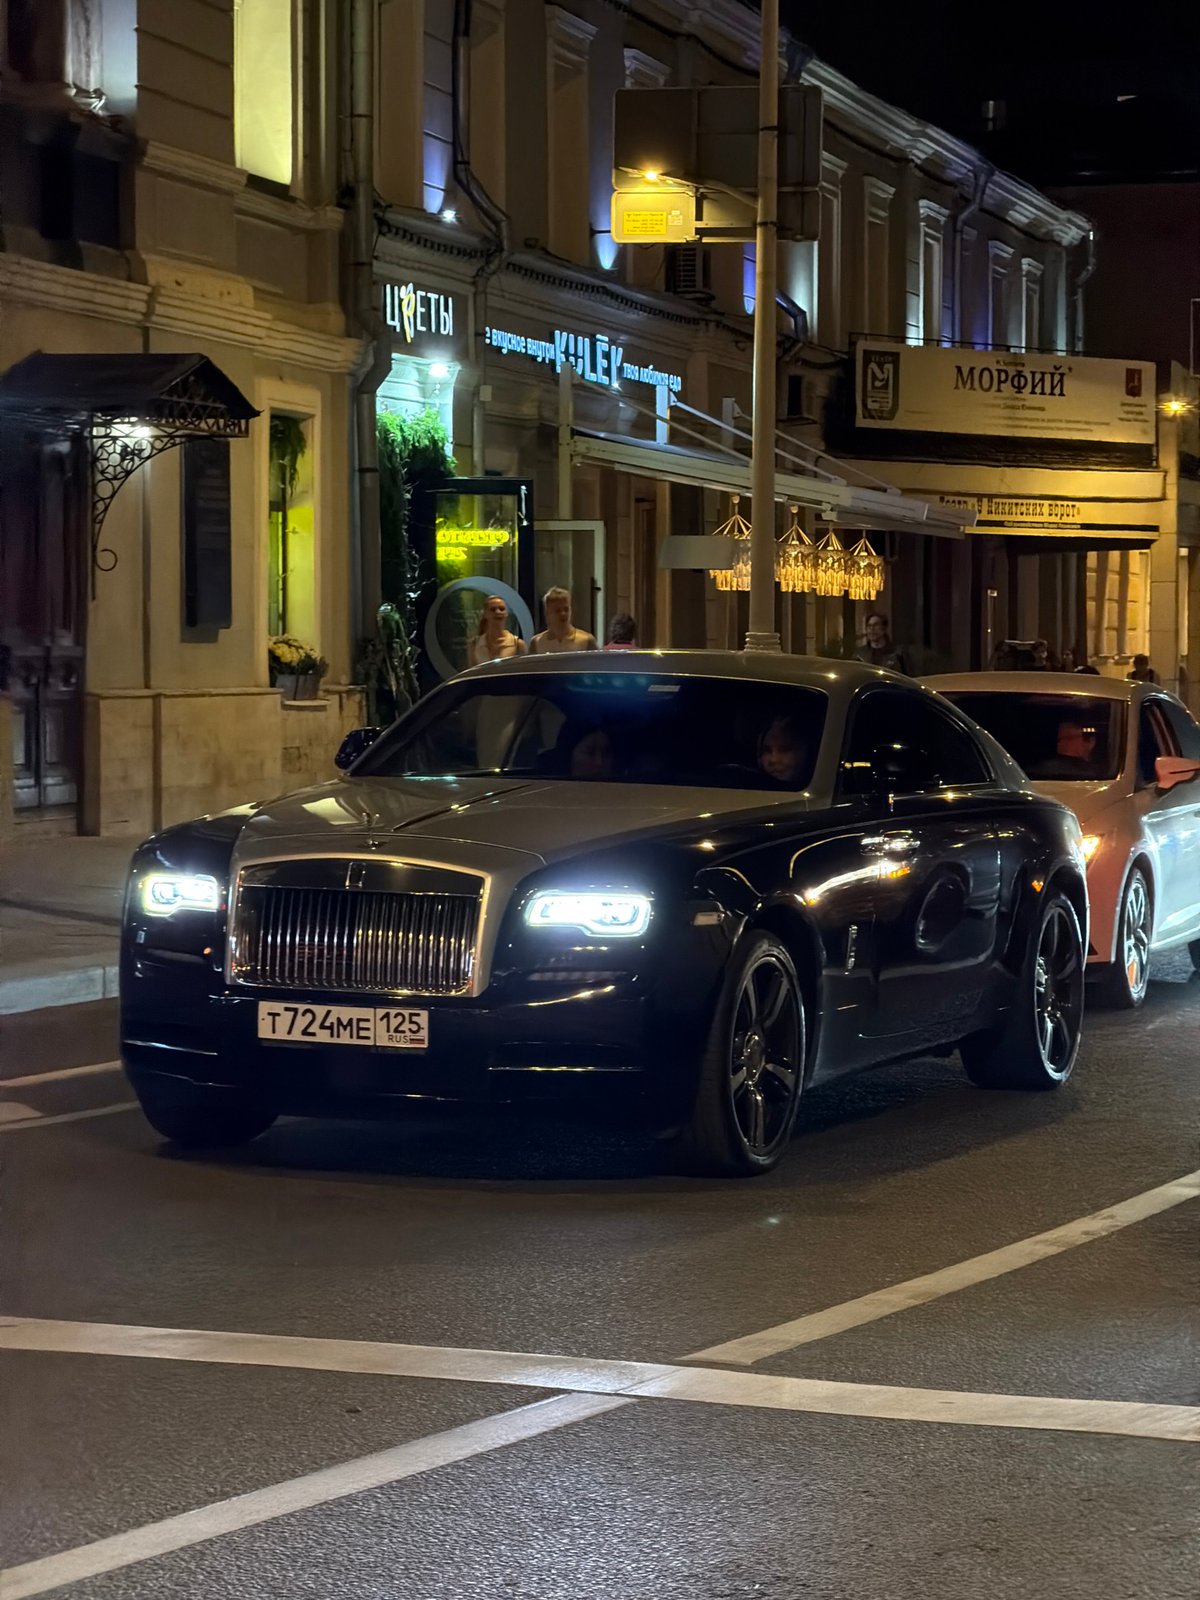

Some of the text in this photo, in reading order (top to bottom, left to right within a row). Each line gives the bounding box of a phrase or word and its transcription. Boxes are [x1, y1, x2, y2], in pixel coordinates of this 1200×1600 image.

[386, 282, 453, 343] ЦВЕТЫ
[953, 364, 1066, 397] МОРФИЙ
[986, 497, 1045, 517] Никитских
[267, 1006, 422, 1040] Т724МЕ 125
[388, 1034, 409, 1044] RUS
